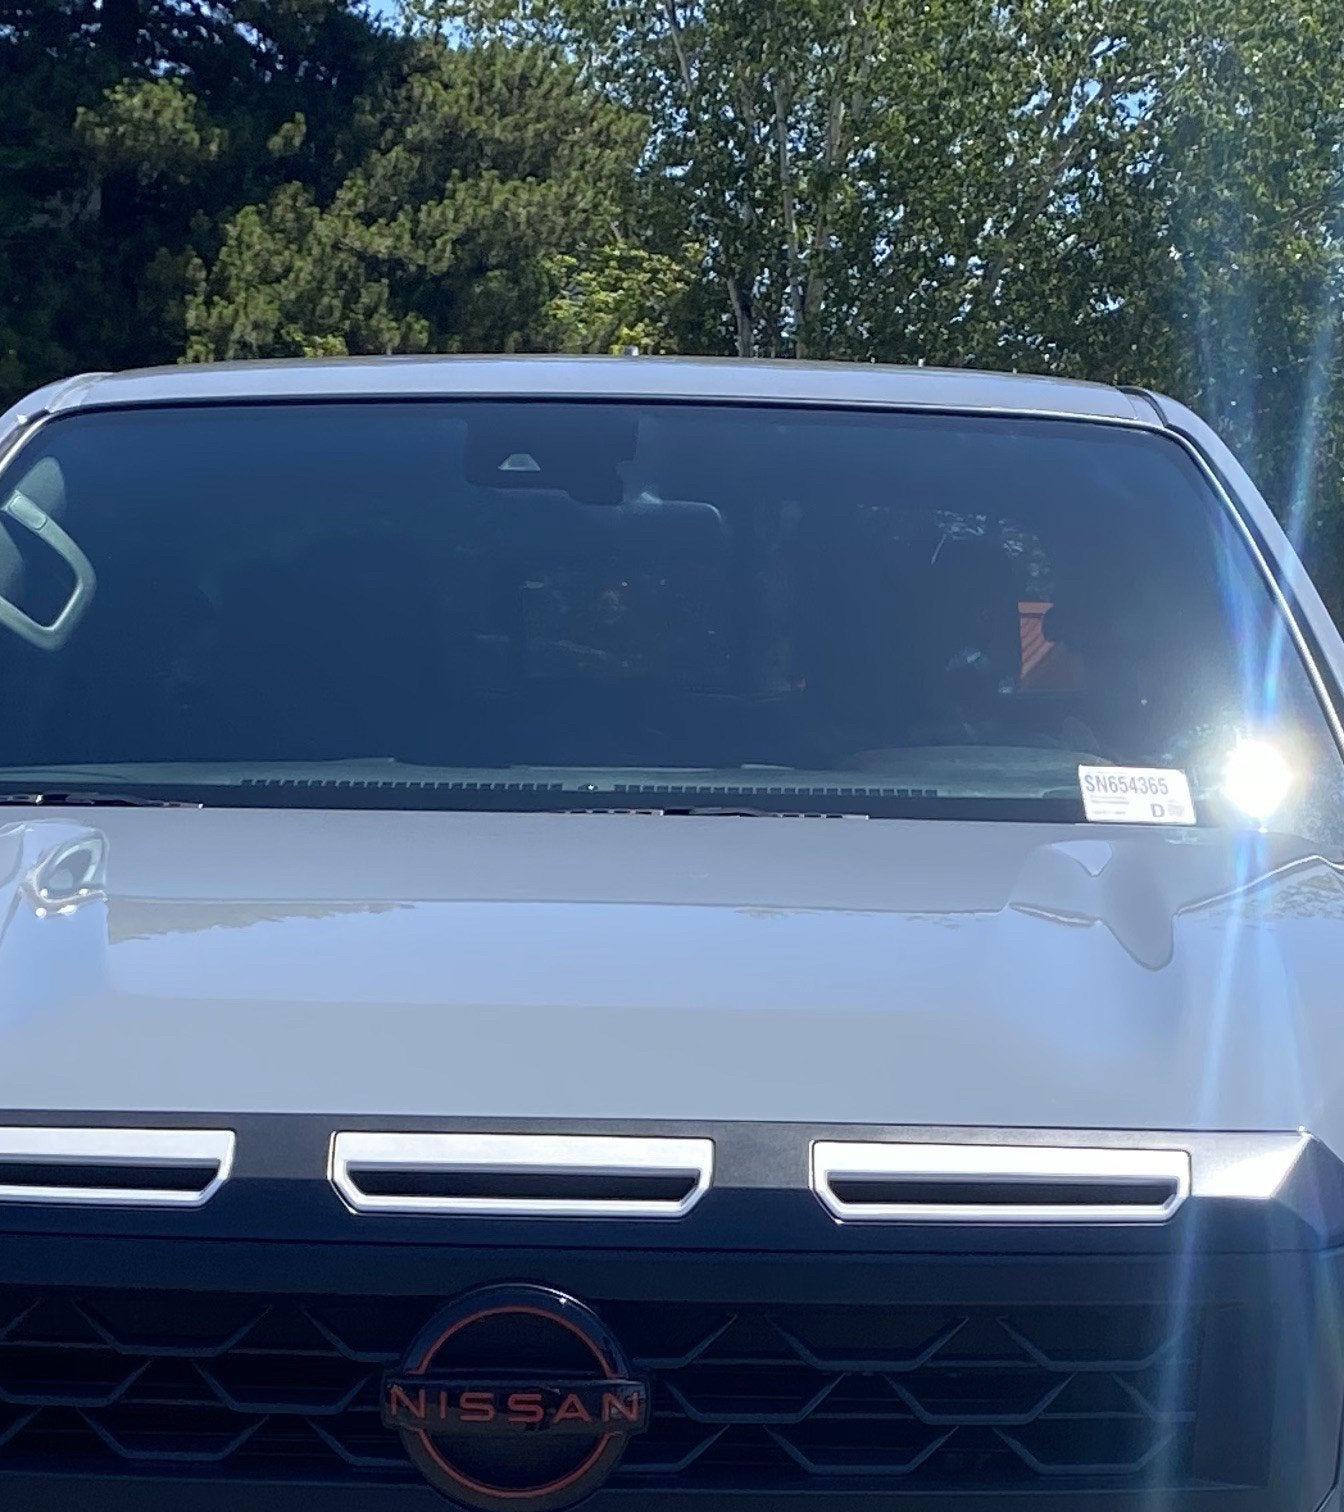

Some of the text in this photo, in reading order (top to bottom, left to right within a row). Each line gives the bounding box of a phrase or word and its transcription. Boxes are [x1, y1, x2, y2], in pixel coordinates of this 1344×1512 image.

[1084, 774, 1169, 796] SN654365
[1150, 803, 1166, 818] D
[387, 1383, 641, 1423] NISSAN
